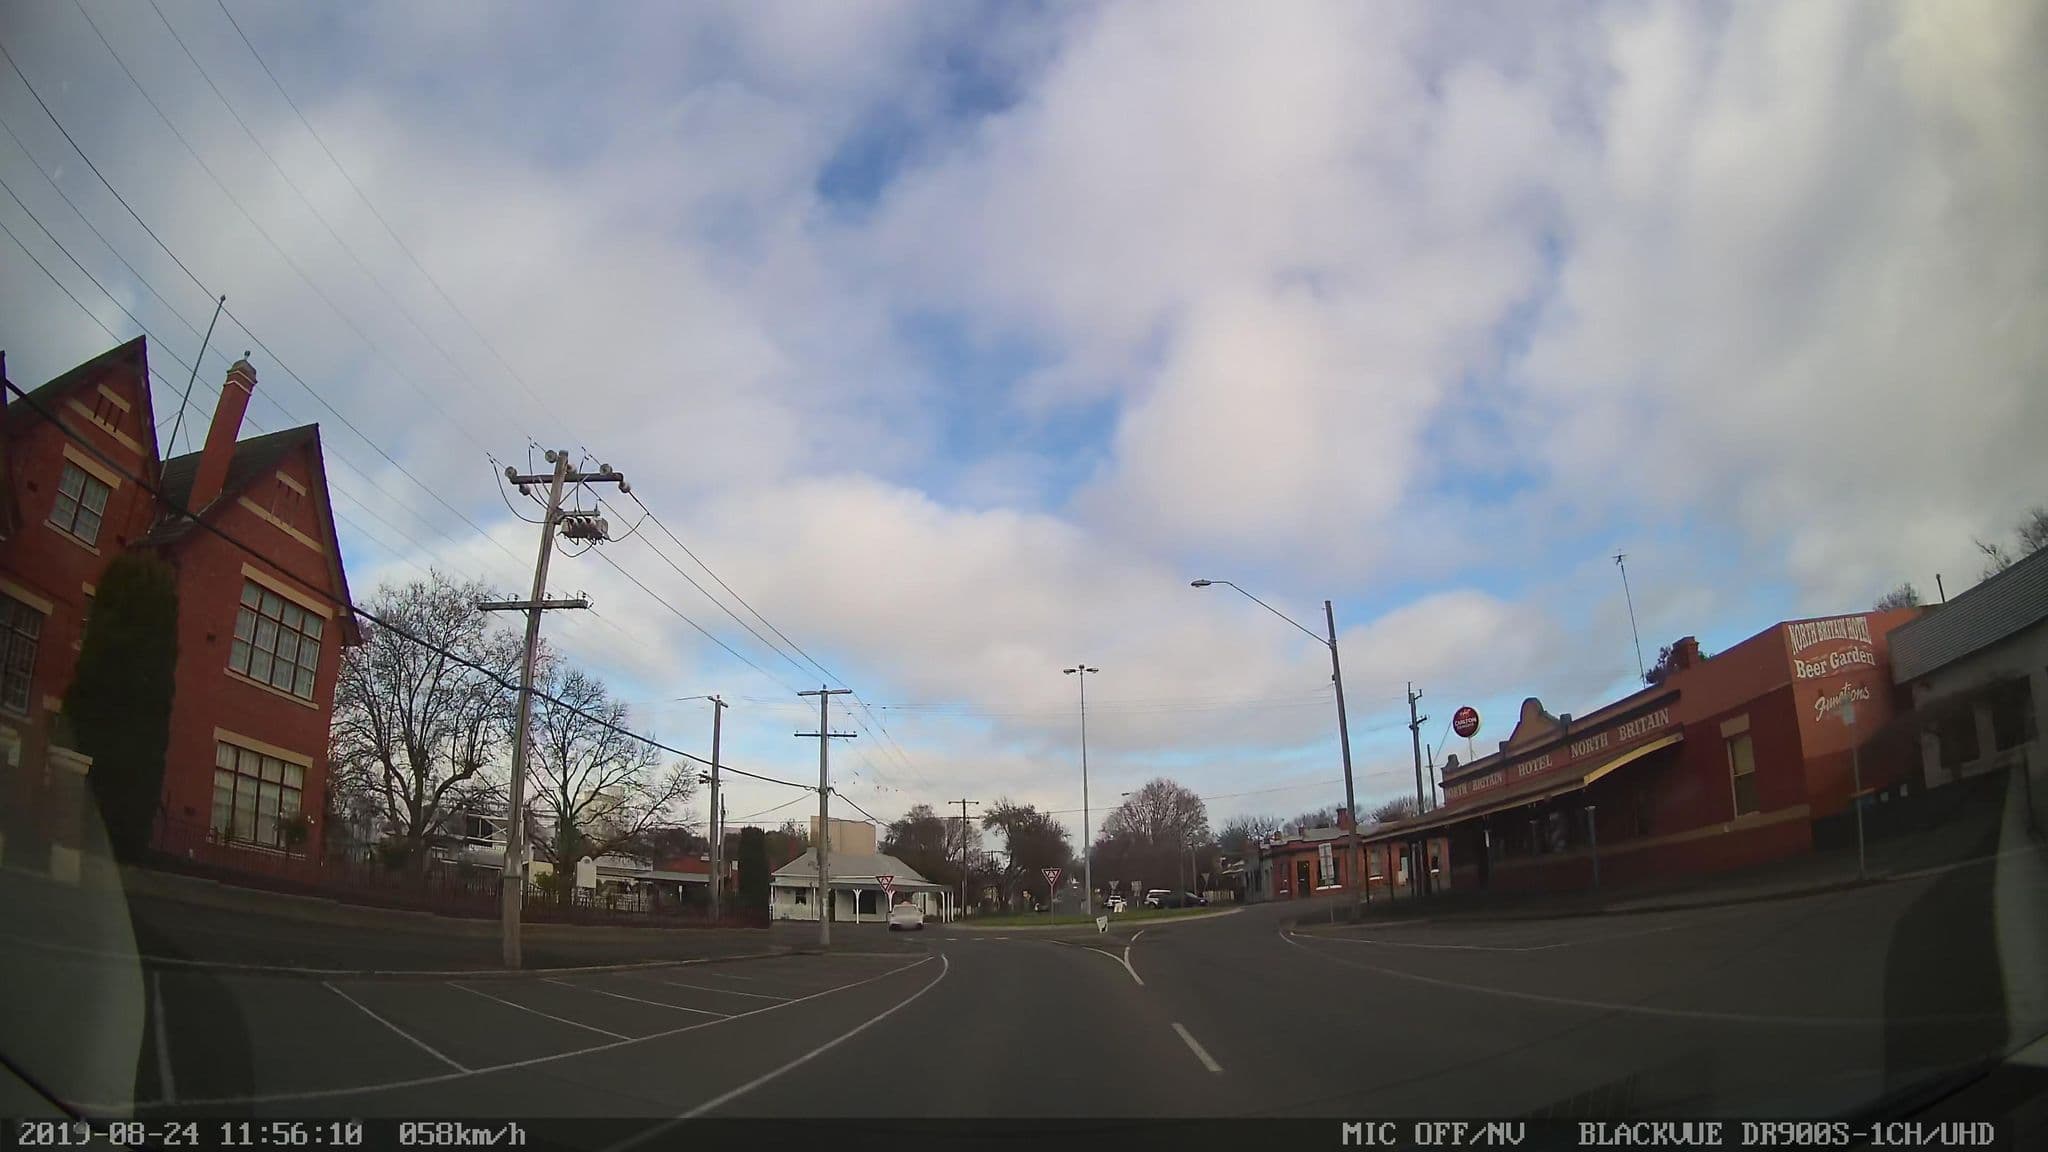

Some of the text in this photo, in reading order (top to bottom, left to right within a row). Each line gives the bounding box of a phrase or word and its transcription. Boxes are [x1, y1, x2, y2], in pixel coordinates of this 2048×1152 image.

[1788, 616, 1873, 655] NORTH BRITAIN HOTEL
[1794, 646, 1876, 679] Beer Garden
[1445, 783, 1468, 800] NORTH
[1518, 754, 1553, 777] HOTEL
[1570, 732, 1609, 759] NORTH
[1617, 707, 1670, 742] BRITAIN
